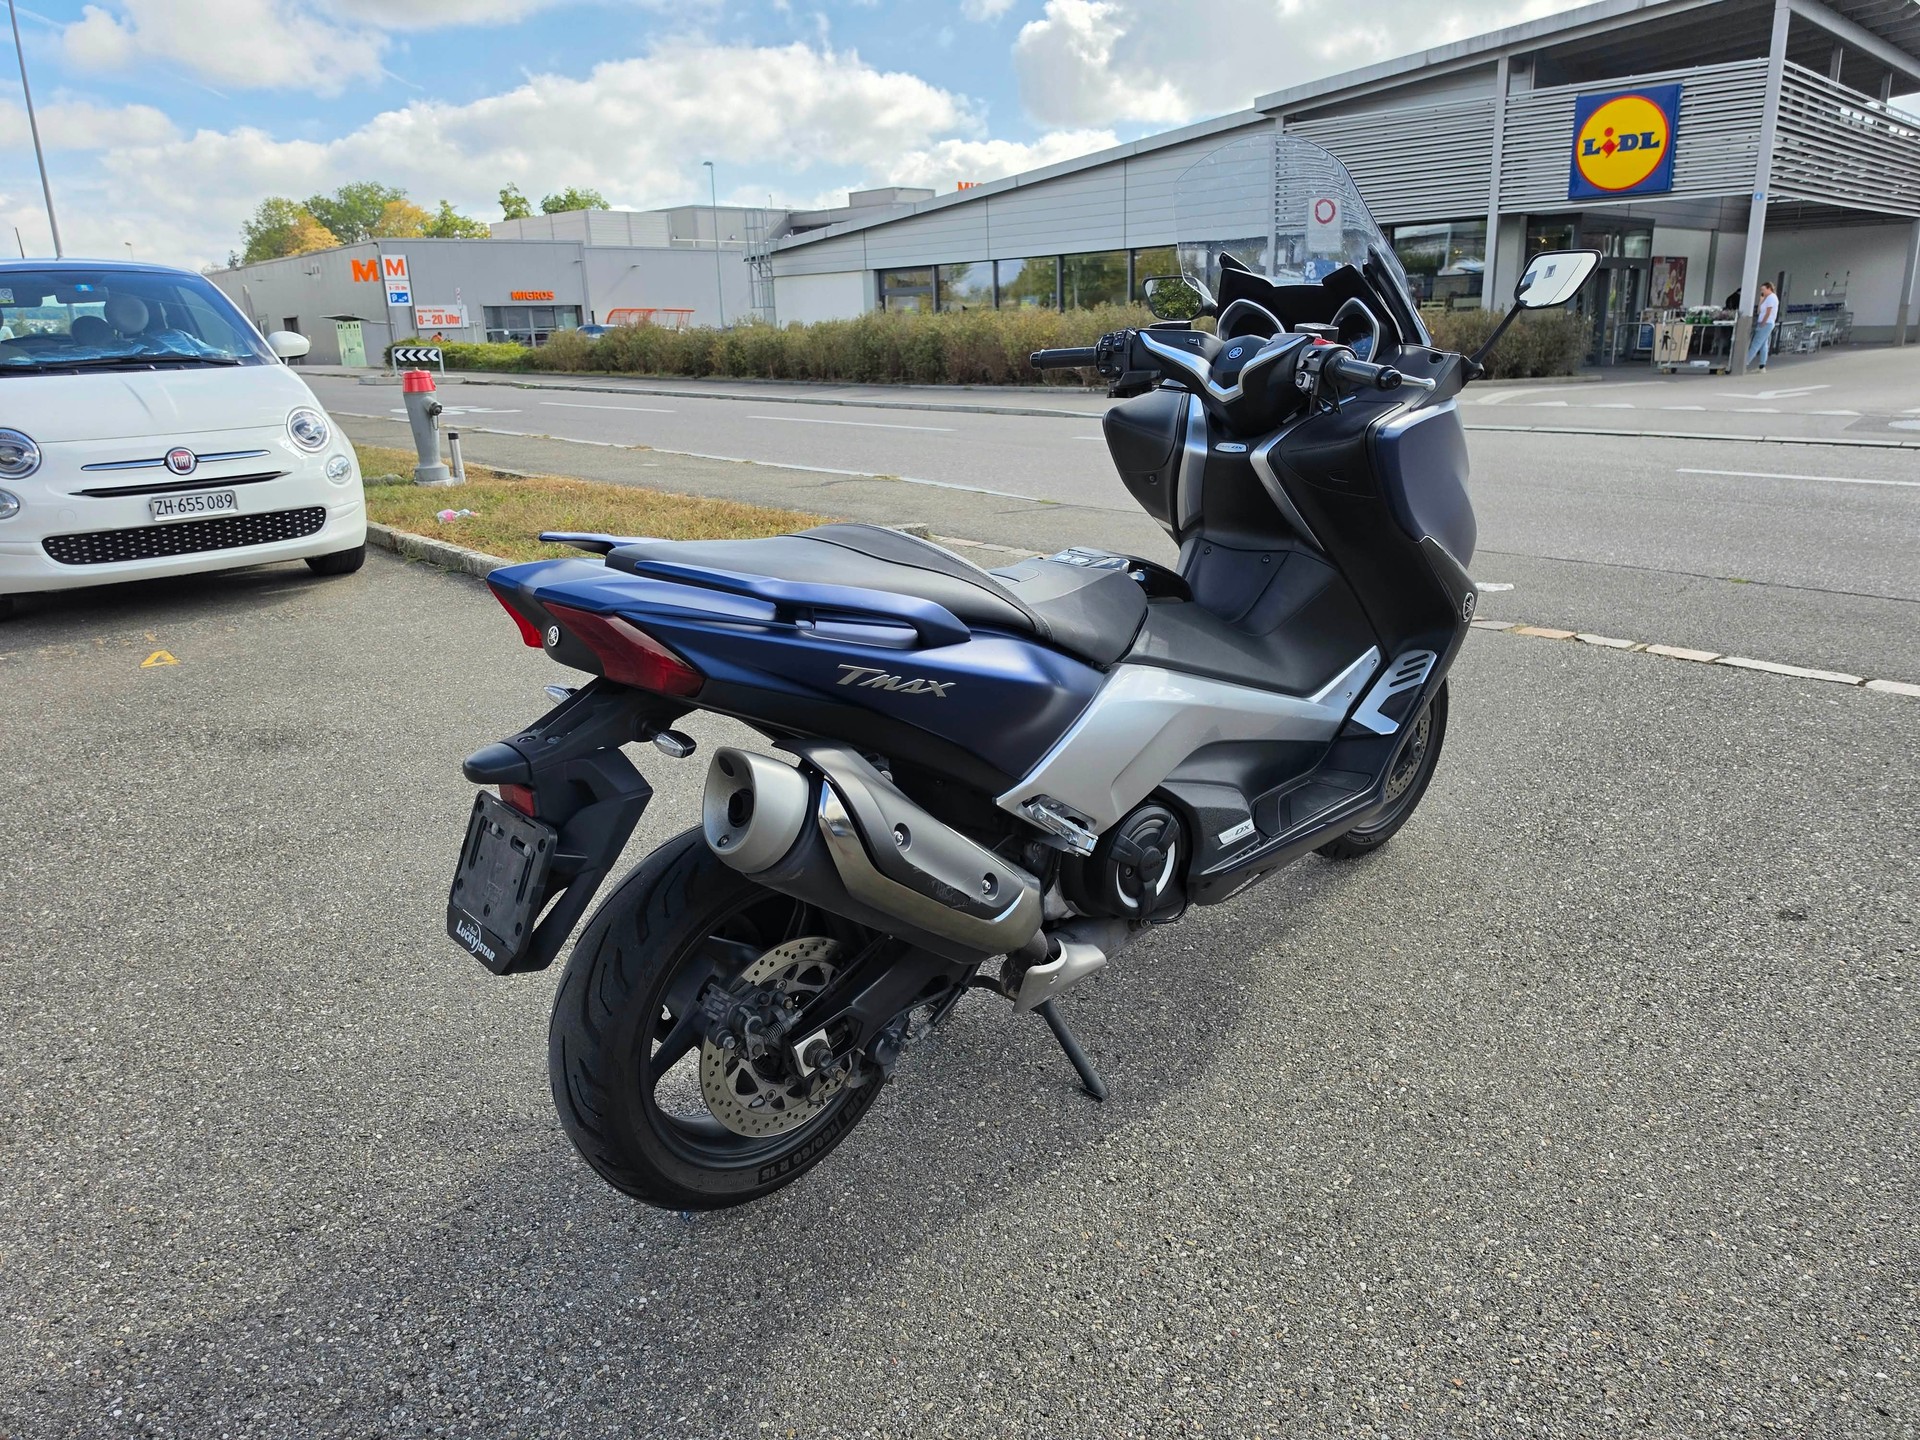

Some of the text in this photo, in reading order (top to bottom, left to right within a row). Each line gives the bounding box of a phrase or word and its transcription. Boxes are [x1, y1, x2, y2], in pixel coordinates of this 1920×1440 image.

[351, 259, 379, 282] M
[385, 259, 405, 276] M
[511, 291, 555, 301] MIGROS
[445, 314, 460, 324] Uhr
[174, 455, 191, 468] FIAT
[207, 494, 233, 509] 089
[837, 664, 956, 697] TMAX
[477, 942, 496, 962] STAR
[793, 1121, 839, 1165] 160/60
[779, 1159, 790, 1172] R
[761, 1167, 777, 1181] 15
